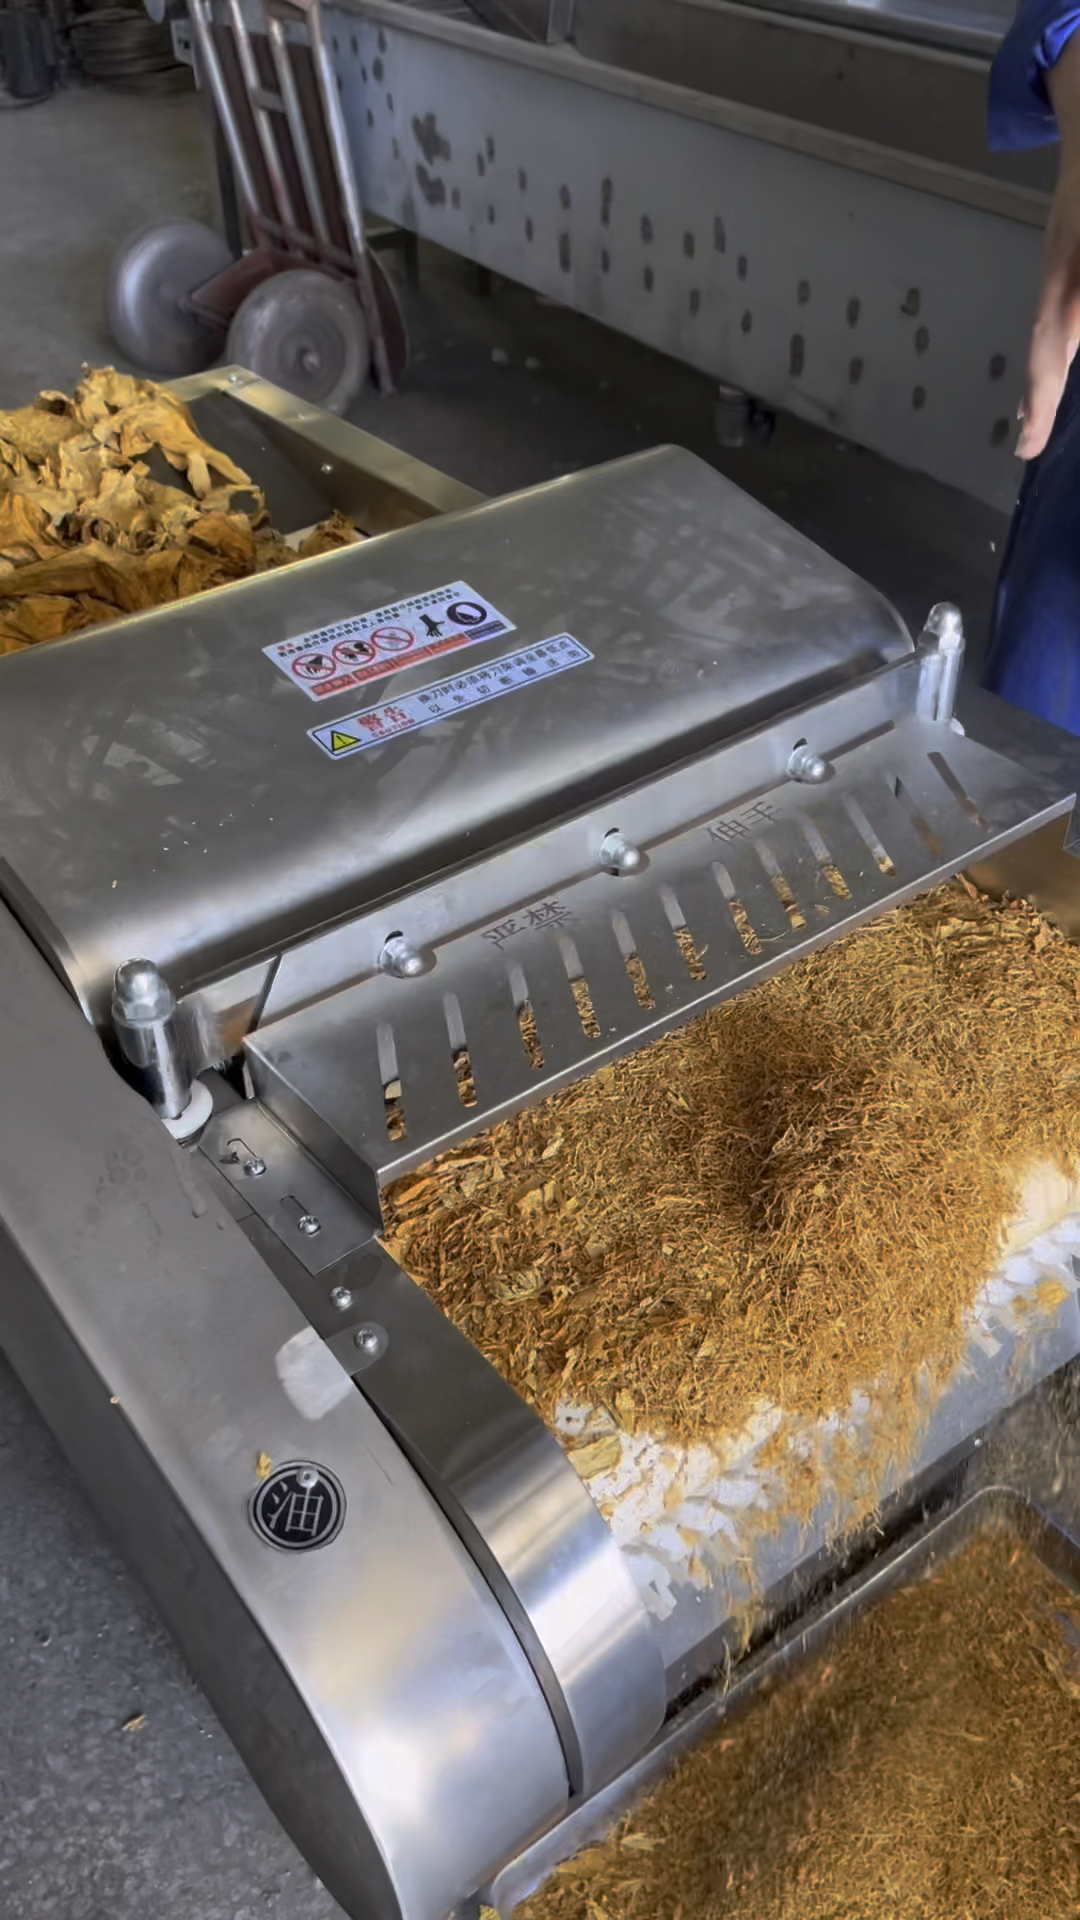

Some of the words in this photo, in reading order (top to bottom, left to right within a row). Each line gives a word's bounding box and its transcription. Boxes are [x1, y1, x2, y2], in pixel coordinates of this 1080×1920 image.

[480, 901, 577, 951] 严禁
[706, 801, 781, 846] 伸手
[266, 1478, 325, 1537] 油
